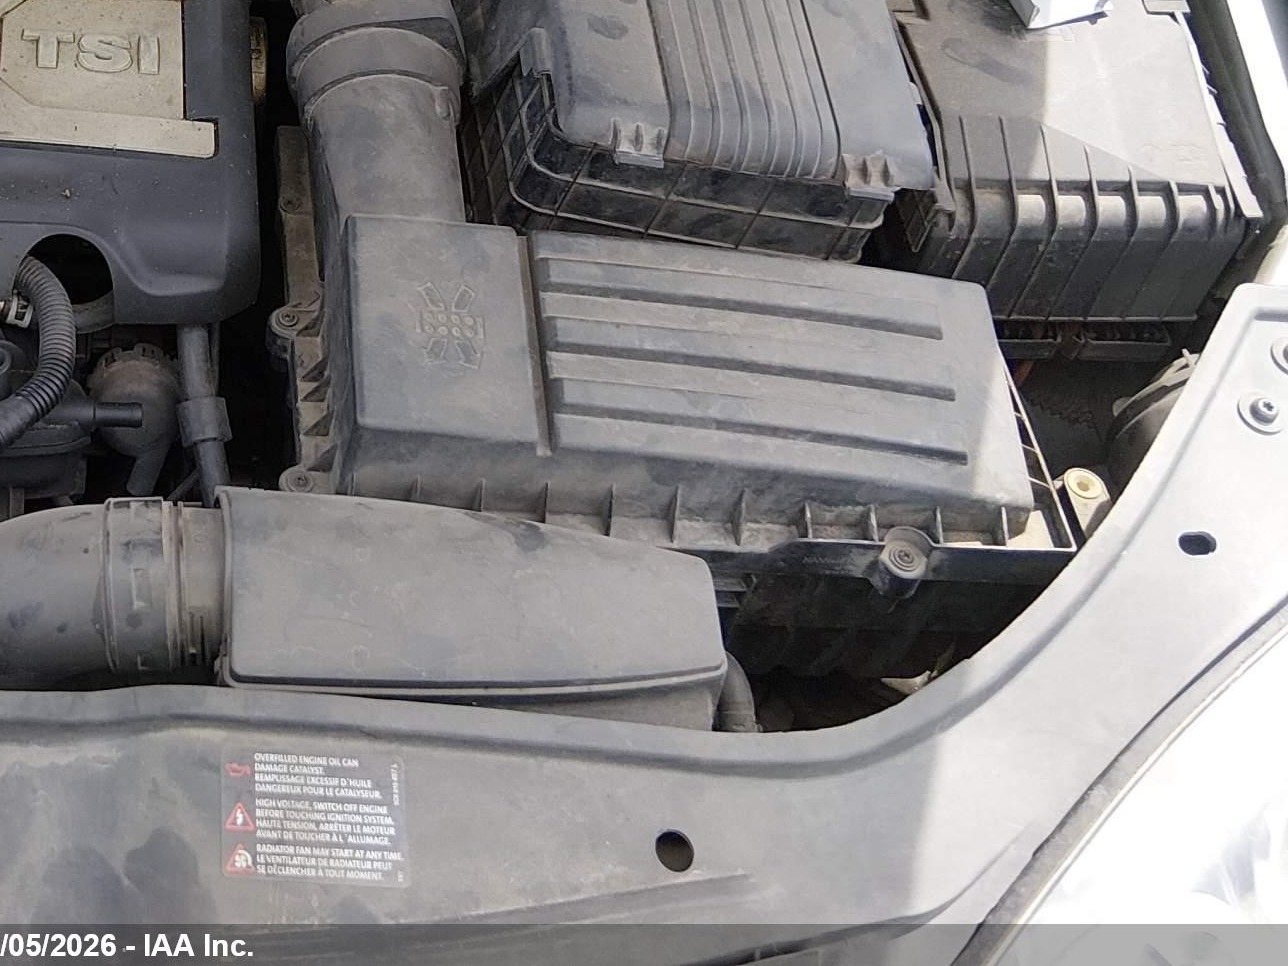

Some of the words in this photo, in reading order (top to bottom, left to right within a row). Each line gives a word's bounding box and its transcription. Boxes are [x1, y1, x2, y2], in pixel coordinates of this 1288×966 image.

[21, 29, 161, 75] TSI
[254, 752, 297, 762] OVERFILLED
[298, 755, 327, 764] ENGINE
[328, 757, 340, 765] OIL
[342, 758, 358, 766] CAN
[254, 762, 287, 772] DAMAGE
[289, 764, 324, 775] CATALYST.
[306, 775, 339, 786] EXCESSIF
[255, 782, 301, 793] DANGEREUX
[302, 785, 324, 795] POUR
[255, 797, 275, 807] HIGH
[312, 801, 341, 811] SWITCH
[343, 803, 356, 812] OFF
[359, 804, 387, 814] ENGINE
[256, 808, 284, 818] BEFORE
[285, 810, 326, 821] TOUCHING
[327, 812, 361, 823] IGNITION
[256, 818, 281, 828] HAUTE
[362, 825, 395, 835] MOTEUR
[256, 828, 281, 838] AVANT
[294, 831, 330, 841] TOUCHER
[256, 843, 294, 854] RADIATOR
[296, 845, 310, 855] FAN
[312, 846, 328, 856] MAY
[330, 847, 353, 858] START
[365, 850, 381, 859] ANY
[266, 854, 316, 865] VENTILATEUR
[329, 858, 371, 869] RADIATEUR
[373, 861, 392, 871] PEUT
[325, 868, 344, 879] TOUT
